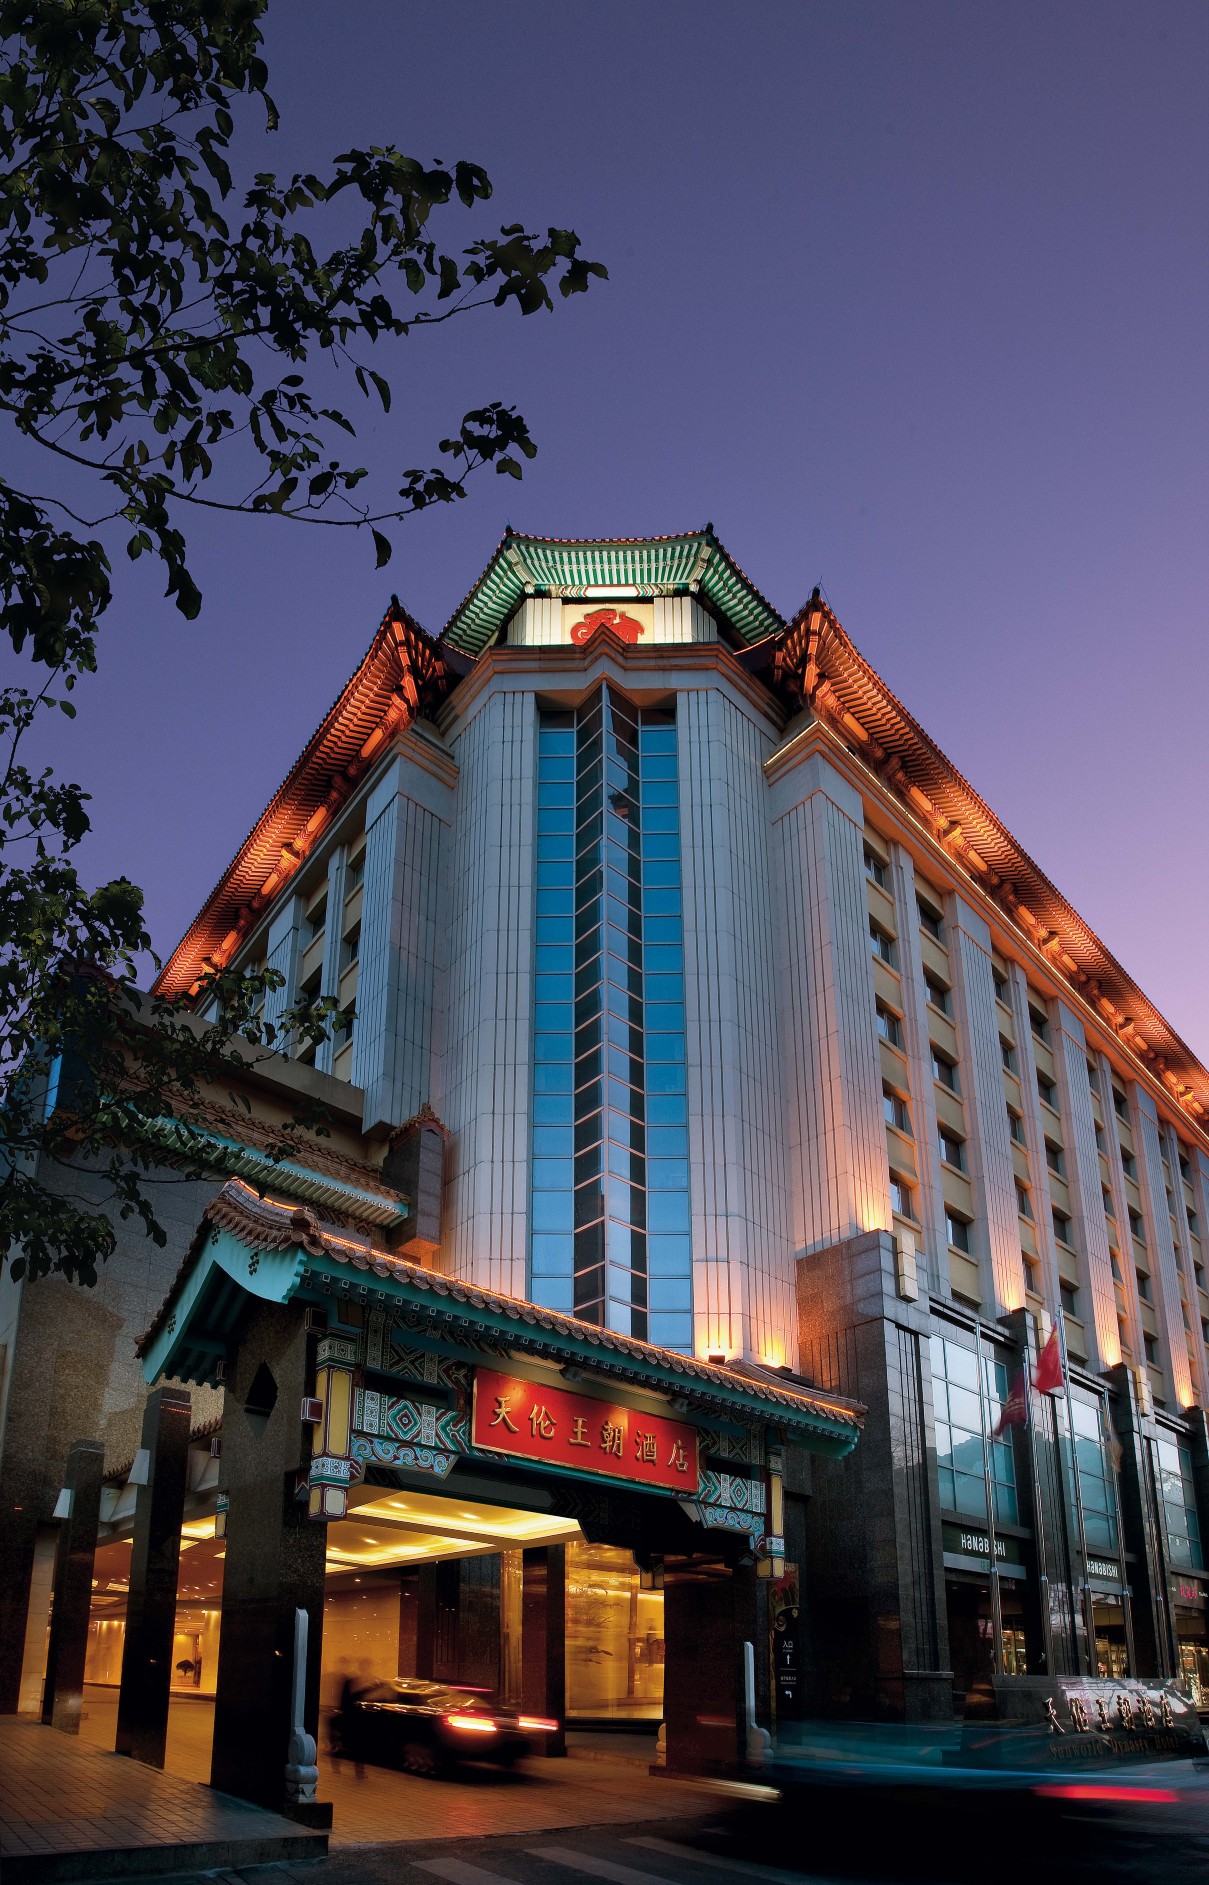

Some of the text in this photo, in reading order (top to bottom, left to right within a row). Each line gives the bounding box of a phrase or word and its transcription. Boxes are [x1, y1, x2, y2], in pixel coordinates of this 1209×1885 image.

[490, 1395, 689, 1473] 天伦王朝酒店
[782, 1640, 794, 1648] 入口
[1050, 1734, 1180, 1760] Sunworld Dynasty Hotel
